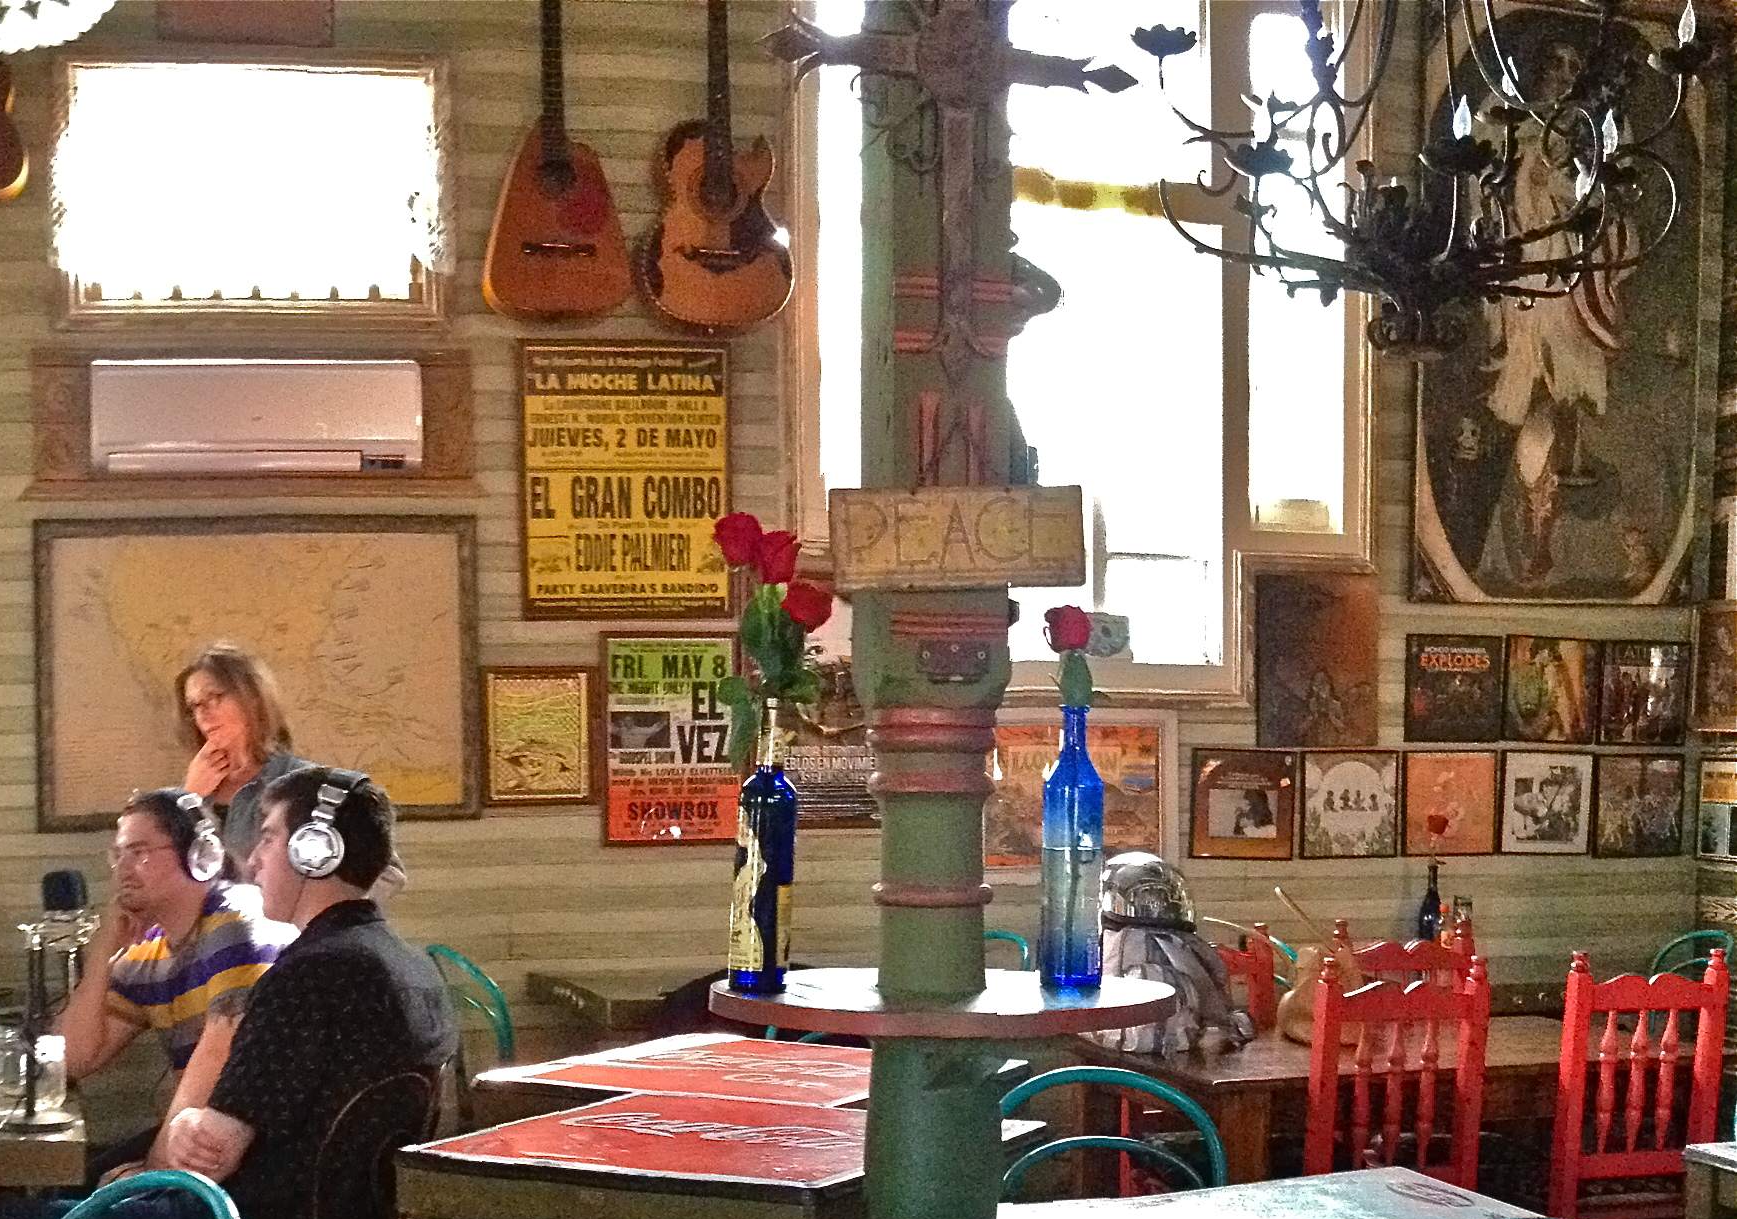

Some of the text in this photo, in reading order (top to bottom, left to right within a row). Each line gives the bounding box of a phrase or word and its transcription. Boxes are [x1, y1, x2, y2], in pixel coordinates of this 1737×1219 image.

[616, 428, 627, 449] 2
[637, 428, 659, 449] DE
[665, 428, 717, 449] MAYO
[530, 475, 721, 520] EL GRAN COMBO
[844, 496, 1069, 569] PEACE
[575, 533, 691, 571] EDDIE PALMIERI
[662, 655, 704, 678] MAY
[712, 655, 726, 678] 8
[1419, 653, 1490, 669] EXPLODES
[692, 681, 724, 720] EL
[677, 725, 731, 763] VEZ
[628, 801, 719, 821] SHOWBOX
